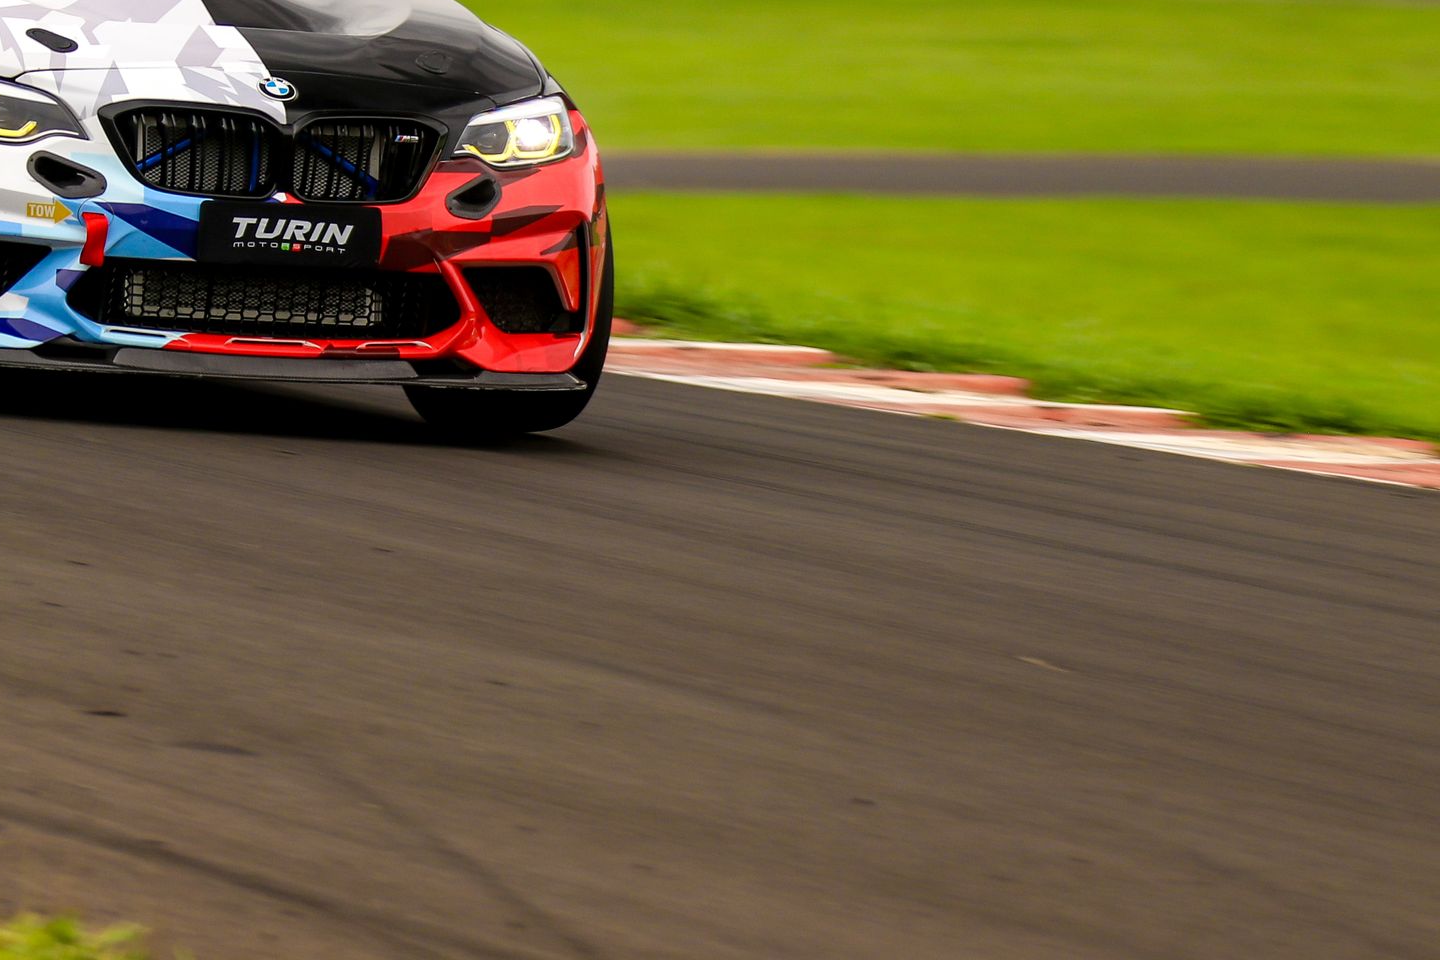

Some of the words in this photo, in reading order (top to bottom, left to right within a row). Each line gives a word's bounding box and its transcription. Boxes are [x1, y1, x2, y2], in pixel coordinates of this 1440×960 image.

[28, 203, 56, 218] TOW
[232, 216, 355, 246] TURIN
[232, 241, 346, 254] MOTORSPORT
